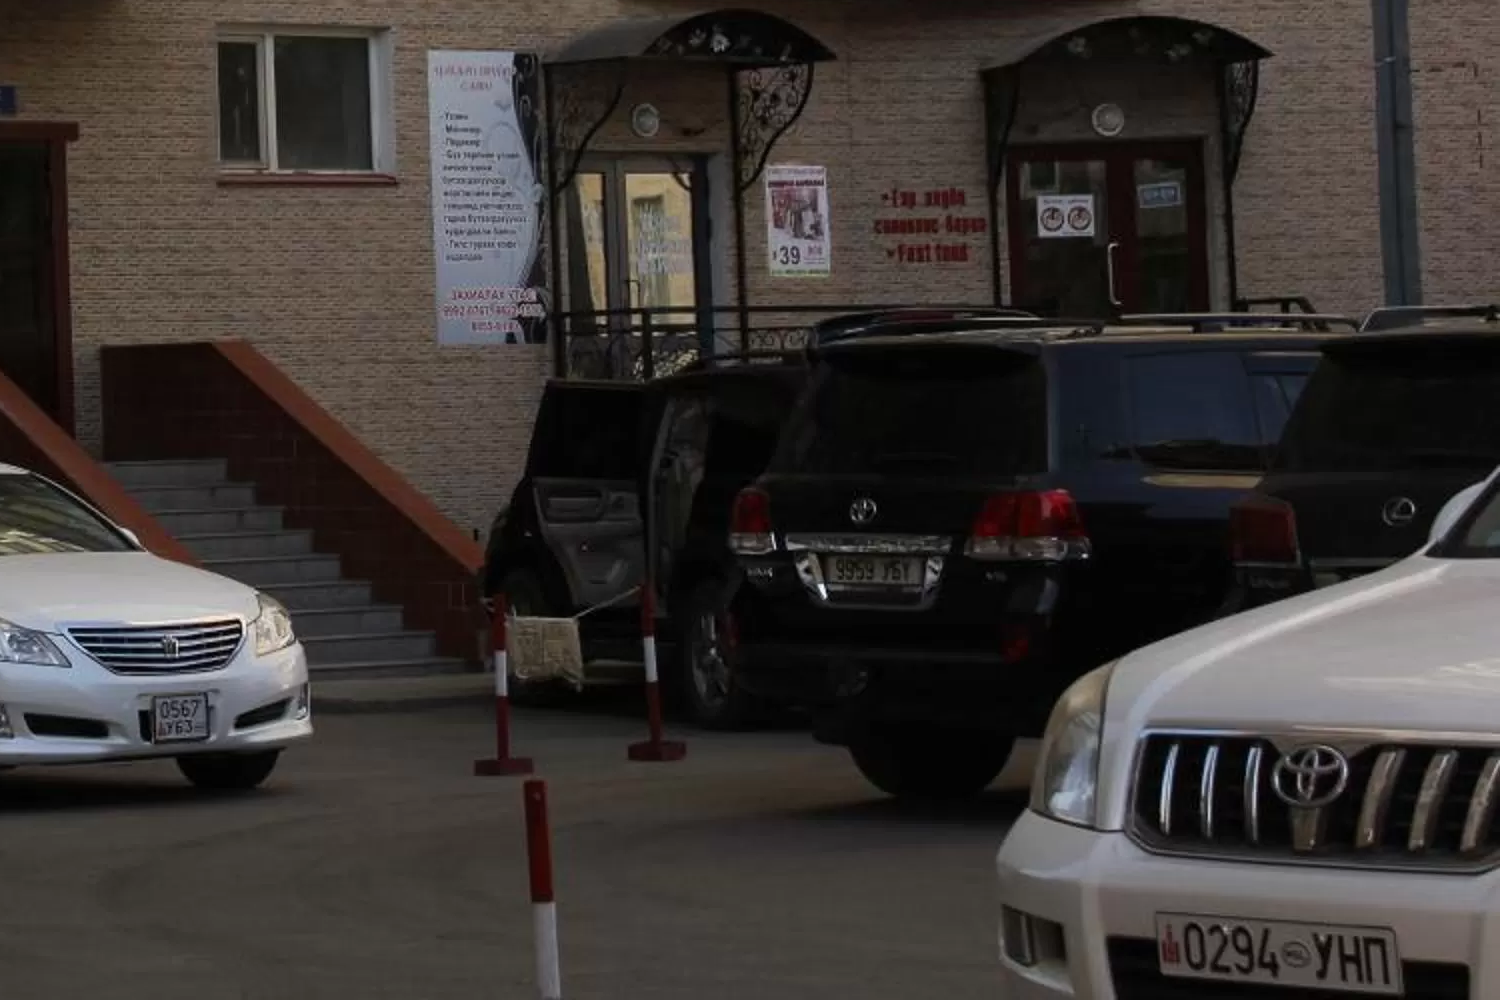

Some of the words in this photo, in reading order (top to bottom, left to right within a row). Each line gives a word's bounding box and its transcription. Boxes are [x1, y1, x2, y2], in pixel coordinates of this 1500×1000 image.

[160, 699, 200, 719] 0567
[1184, 922, 1279, 978] 0294
[1312, 931, 1390, 985] УНП
